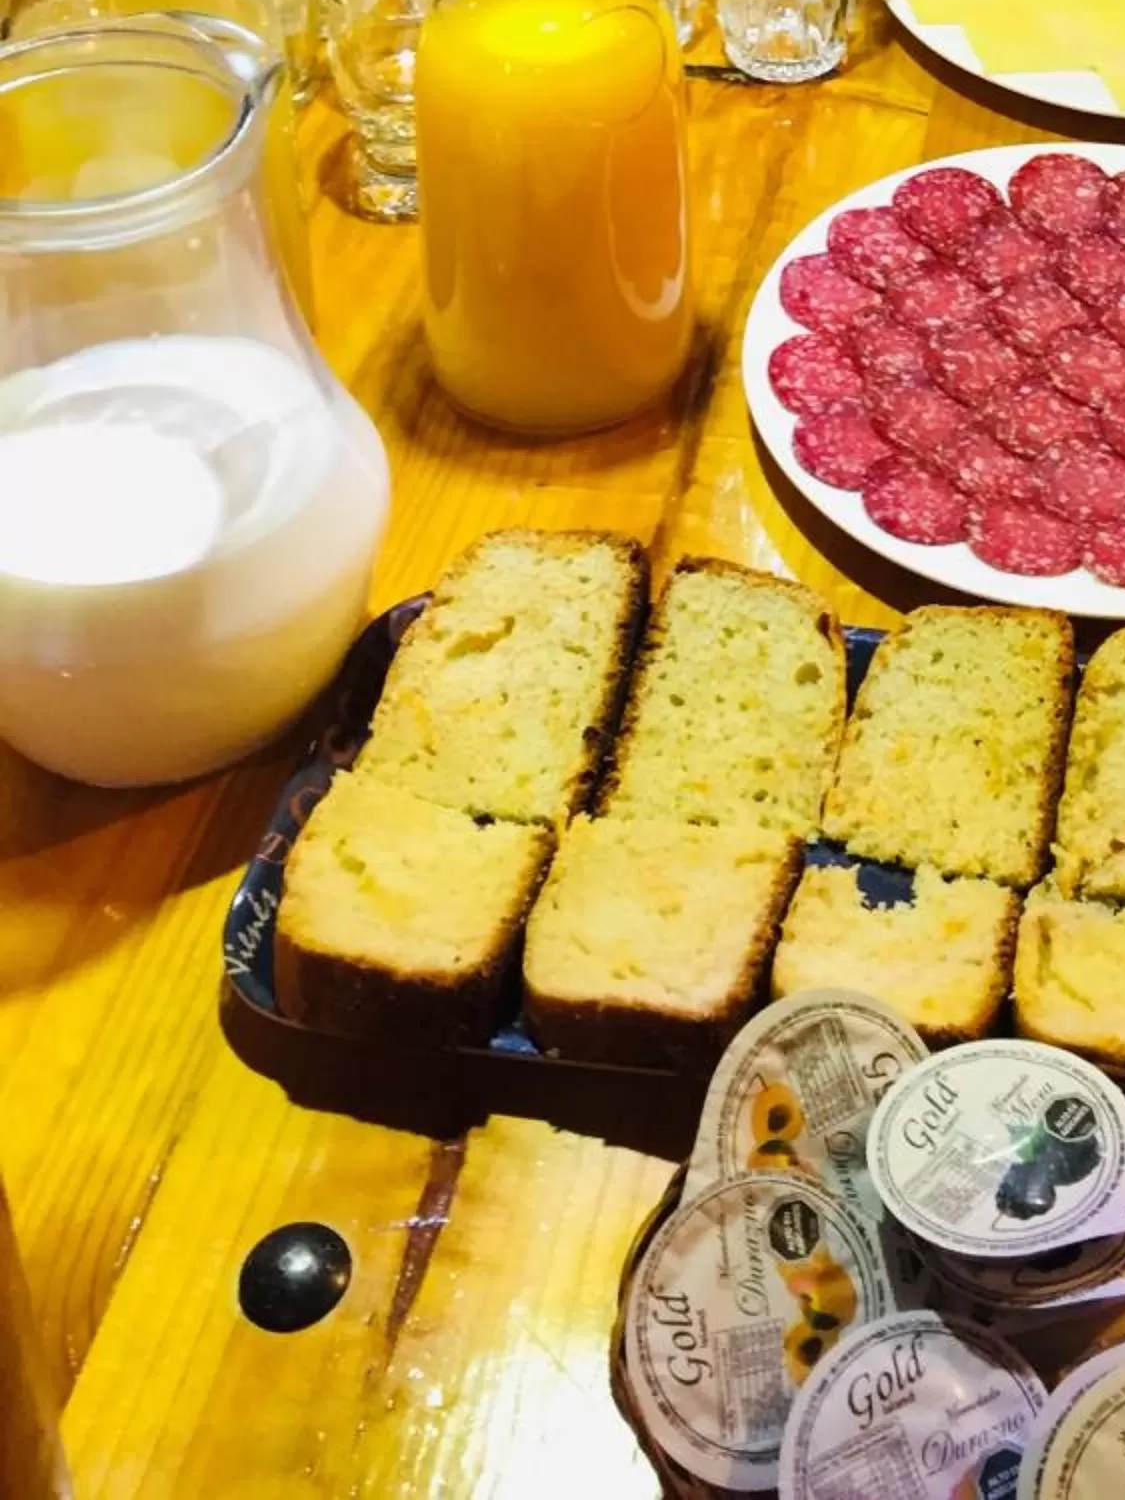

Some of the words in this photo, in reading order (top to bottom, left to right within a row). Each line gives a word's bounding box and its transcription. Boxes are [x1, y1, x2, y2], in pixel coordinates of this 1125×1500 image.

[902, 1070, 959, 1155] Gold
[734, 1190, 772, 1317] Durazno
[648, 1283, 713, 1387] Gold
[847, 1330, 926, 1430] Gold
[920, 1410, 1026, 1477] Durazno
